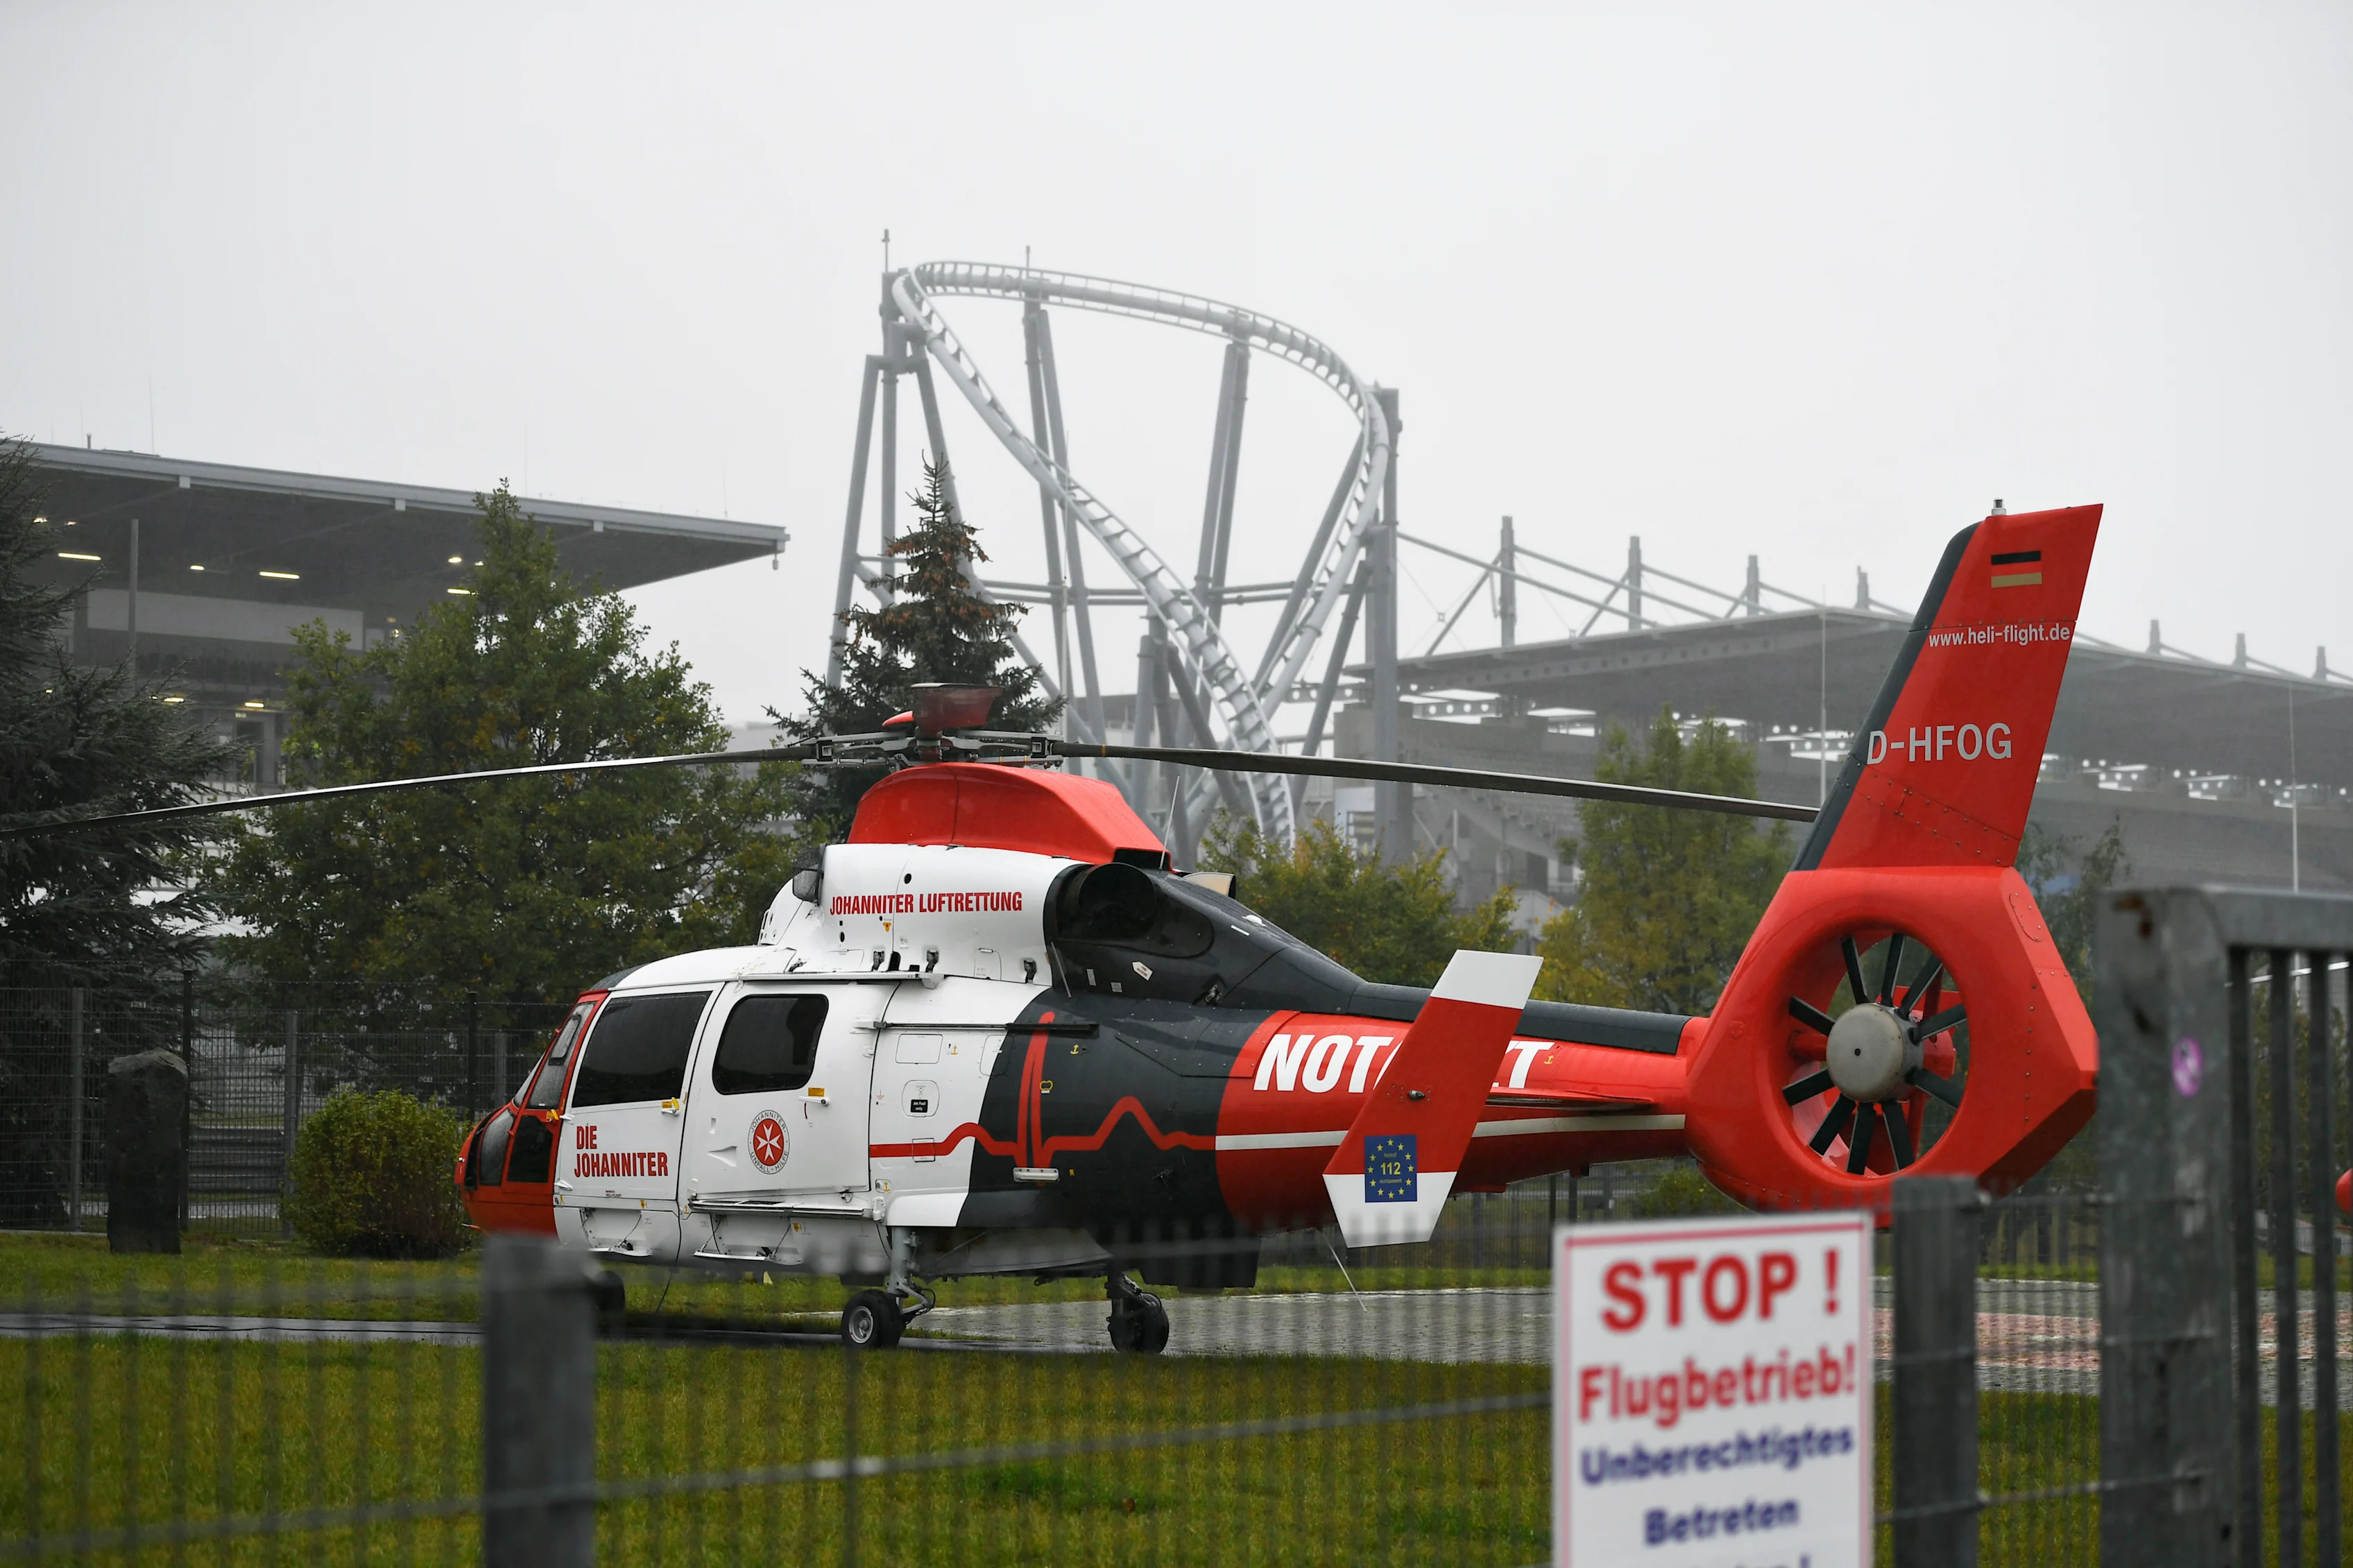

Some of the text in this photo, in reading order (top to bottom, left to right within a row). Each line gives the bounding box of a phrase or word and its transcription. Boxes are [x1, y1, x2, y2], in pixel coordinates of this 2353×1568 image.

[1928, 623, 2071, 648] www.heli-flight.de
[1867, 722, 2012, 766] D-HFOG
[830, 891, 1023, 915] JOHANNITER LUFTRETTUNG
[1253, 1033, 1555, 1094] NOTT
[576, 1126, 597, 1150] DIE
[574, 1152, 669, 1178] JOHANNITER
[1380, 1162, 1401, 1175] 112
[1600, 1252, 1798, 1334] STOP
[1578, 1343, 1856, 1429] Flugbetrieb!
[1580, 1424, 1854, 1487] Unberechtigtes
[1644, 1497, 1800, 1547] Betreten
